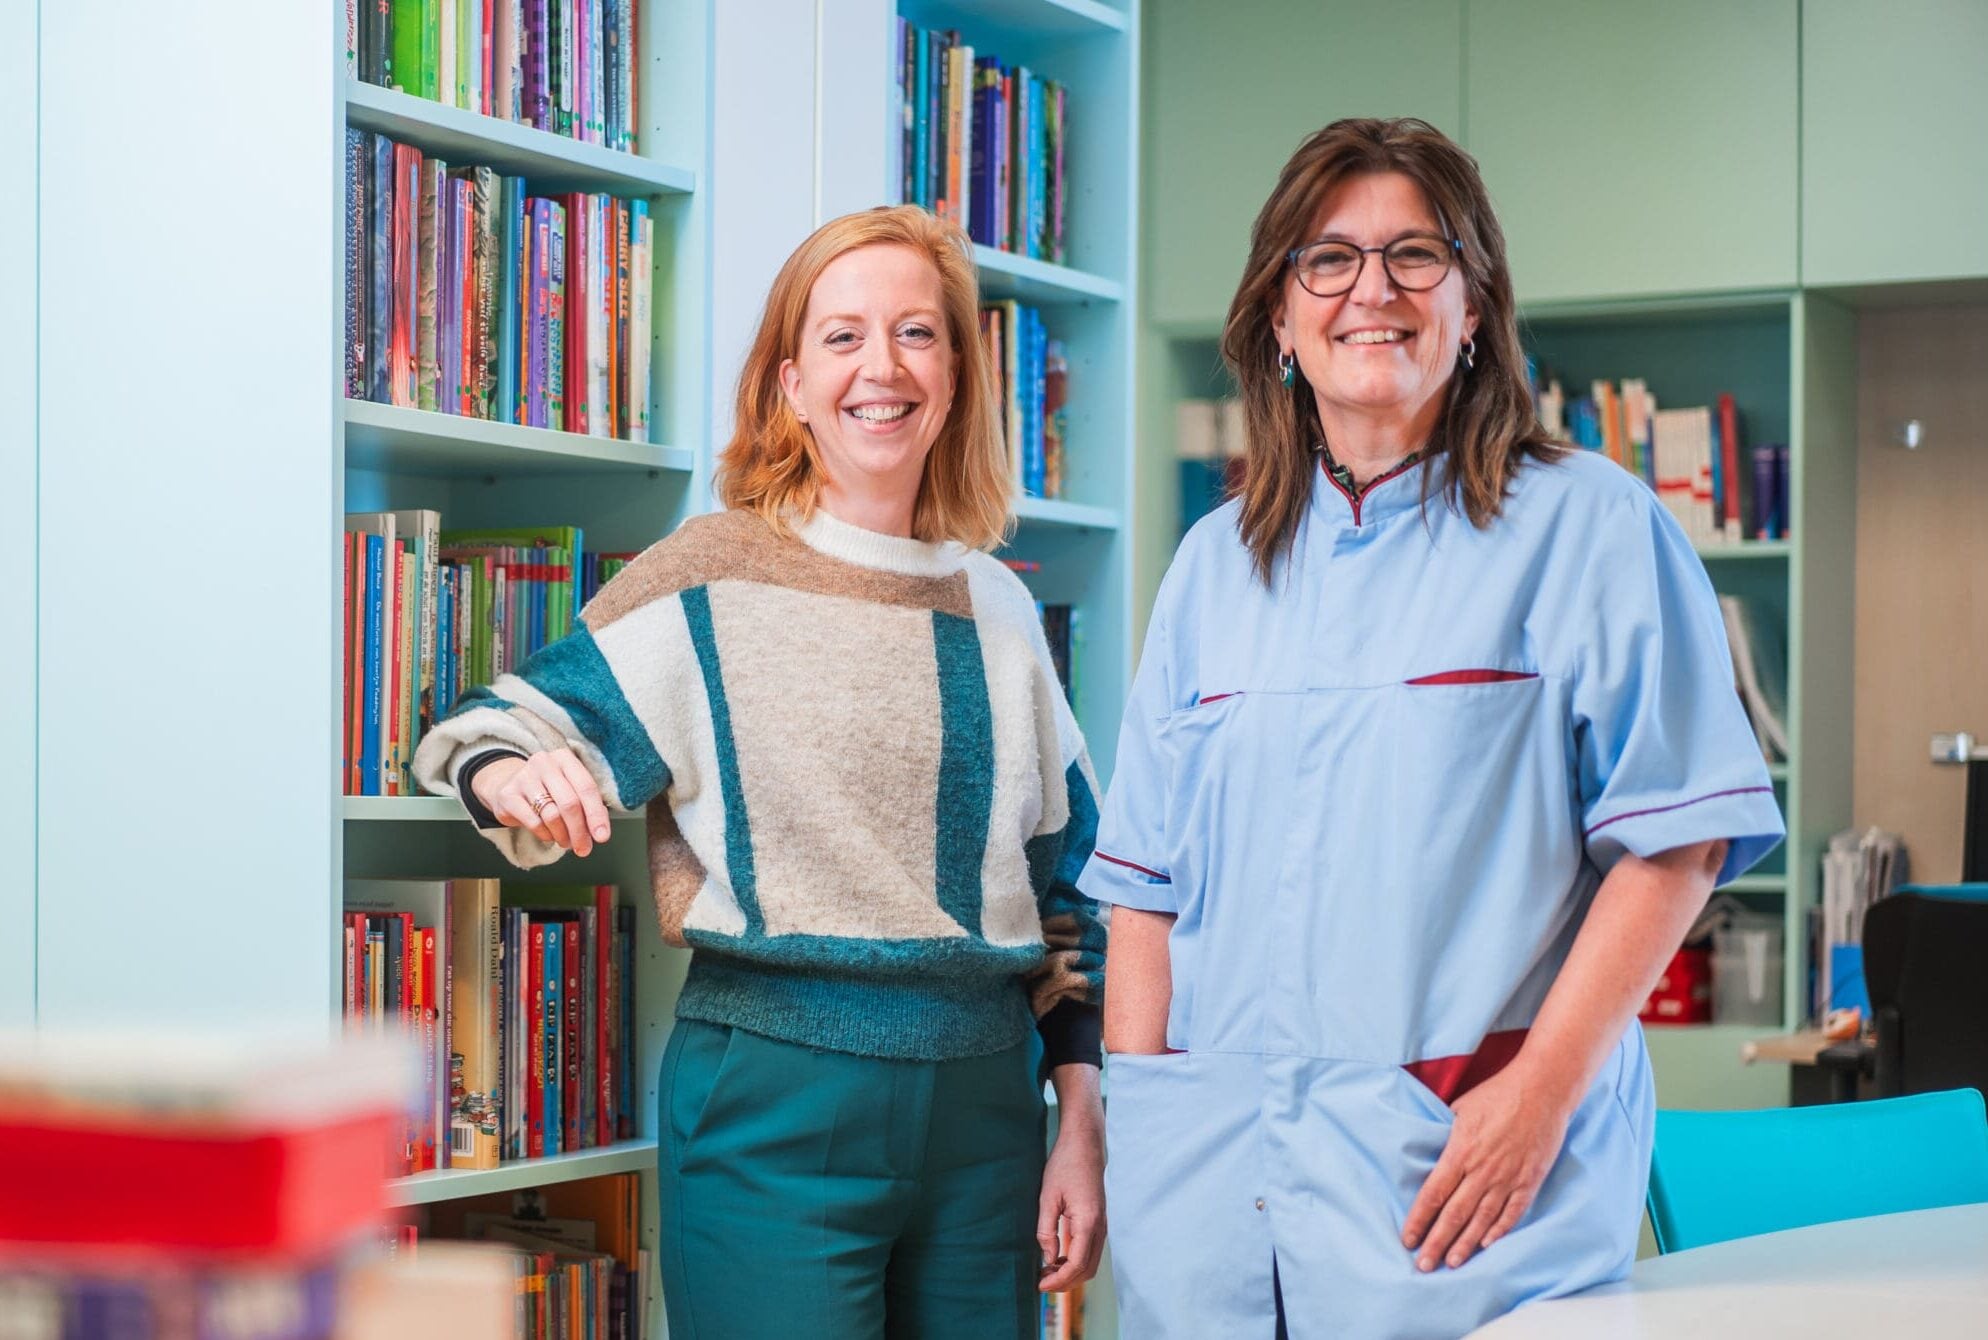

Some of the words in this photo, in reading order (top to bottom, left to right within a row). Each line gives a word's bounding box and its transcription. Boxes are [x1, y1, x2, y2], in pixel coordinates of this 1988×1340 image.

[618, 209, 629, 271] CARRY
[618, 277, 629, 319] SLEE
[372, 687, 380, 726] Paddington
[490, 905, 500, 945] Roald
[490, 947, 500, 980] Dahl
